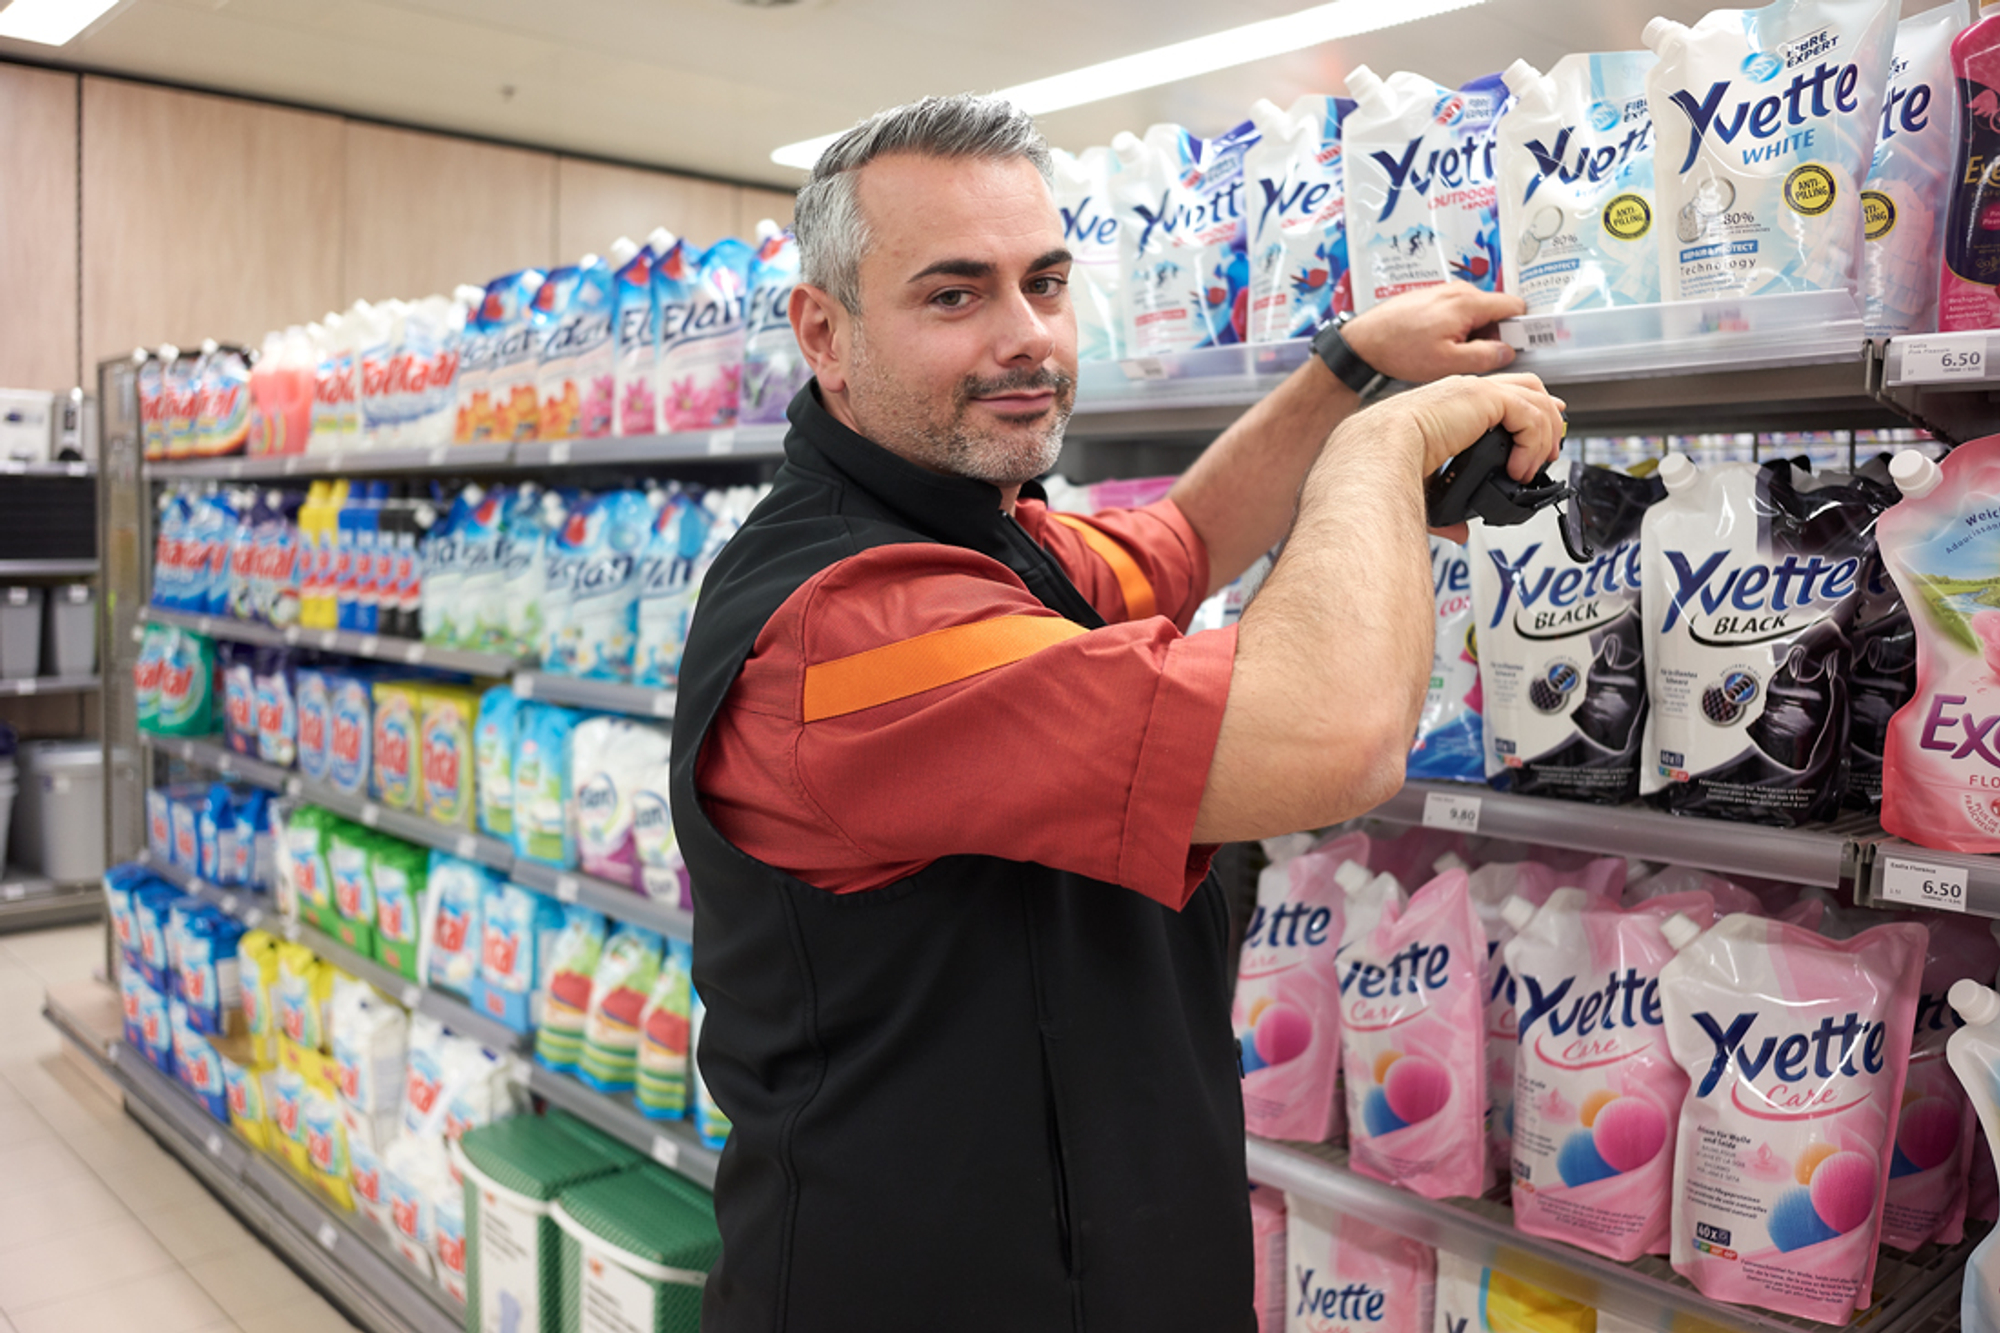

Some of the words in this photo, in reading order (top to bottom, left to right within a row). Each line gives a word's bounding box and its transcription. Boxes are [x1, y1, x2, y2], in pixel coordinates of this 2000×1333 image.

[1787, 35, 1840, 68] EXPERT
[1668, 62, 1858, 175] Yvette
[1742, 128, 1816, 165] WHITE
[1523, 118, 1657, 207] Yvett
[1795, 186, 1828, 201] PILLING
[1798, 178, 1821, 191] ANTI-
[1613, 213, 1643, 227] PILLING
[1616, 205, 1638, 218] ANTI-
[1724, 212, 1756, 225] 80%
[1715, 243, 1755, 255] POTECT
[1942, 351, 1981, 367] 6.50
[1487, 540, 1642, 630] Yvette
[1661, 549, 1858, 634] Yvette
[1535, 600, 1600, 630] BLACK
[1713, 613, 1789, 636] BLACK
[1450, 808, 1476, 822] 9.80
[1922, 880, 1962, 898] 6.50
[1335, 941, 1449, 999] vette
[1519, 968, 1664, 1046] Yvette
[1562, 1038, 1619, 1061] Care
[1691, 1011, 1886, 1098] Yvette
[1765, 1084, 1839, 1108] Care
[1296, 1264, 1385, 1322] Yvette
